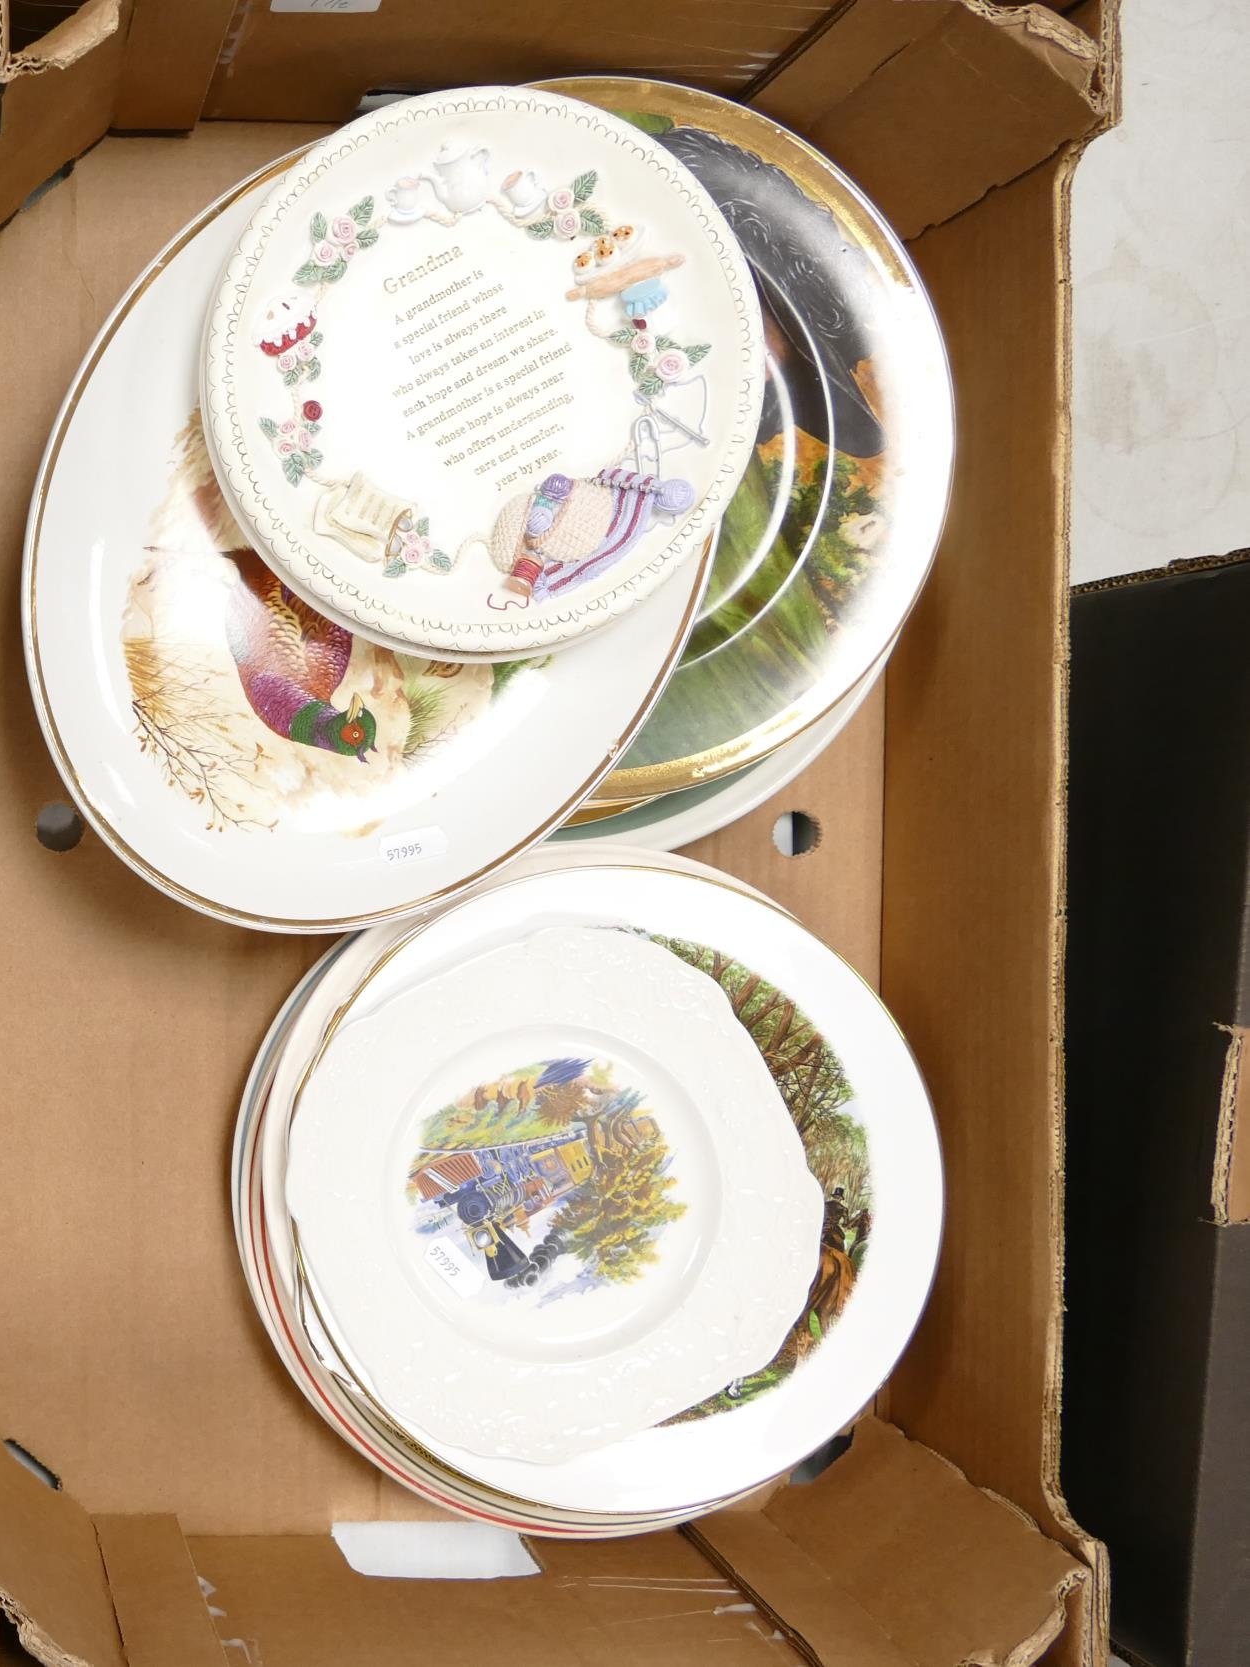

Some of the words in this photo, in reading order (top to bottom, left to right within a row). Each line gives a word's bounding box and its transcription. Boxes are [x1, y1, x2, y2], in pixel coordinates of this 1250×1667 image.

[383, 246, 463, 294] Grandma
[402, 318, 438, 344] special
[438, 300, 470, 324] friend
[472, 283, 503, 304] whose
[406, 276, 471, 320] grandmother
[392, 383, 414, 397] who
[415, 362, 450, 386] always
[451, 347, 478, 366] takes
[493, 316, 533, 342] interest
[408, 349, 432, 365] love
[444, 322, 478, 346] always
[479, 306, 507, 325] there
[403, 400, 426, 417] each
[426, 386, 453, 404] hope
[454, 371, 474, 389] and
[476, 355, 509, 376] dream
[417, 393, 482, 436] grandmother
[504, 360, 539, 386] special
[539, 342, 572, 366] friend
[435, 427, 466, 447] whose
[466, 412, 493, 430] hope
[505, 386, 540, 409] always
[541, 372, 564, 389] near
[443, 452, 465, 467] who
[467, 434, 496, 455] offers
[474, 459, 497, 475] care
[498, 445, 518, 462] and
[495, 471, 517, 491] year
[386, 843, 422, 861] 57995
[430, 1246, 460, 1276] 57995
